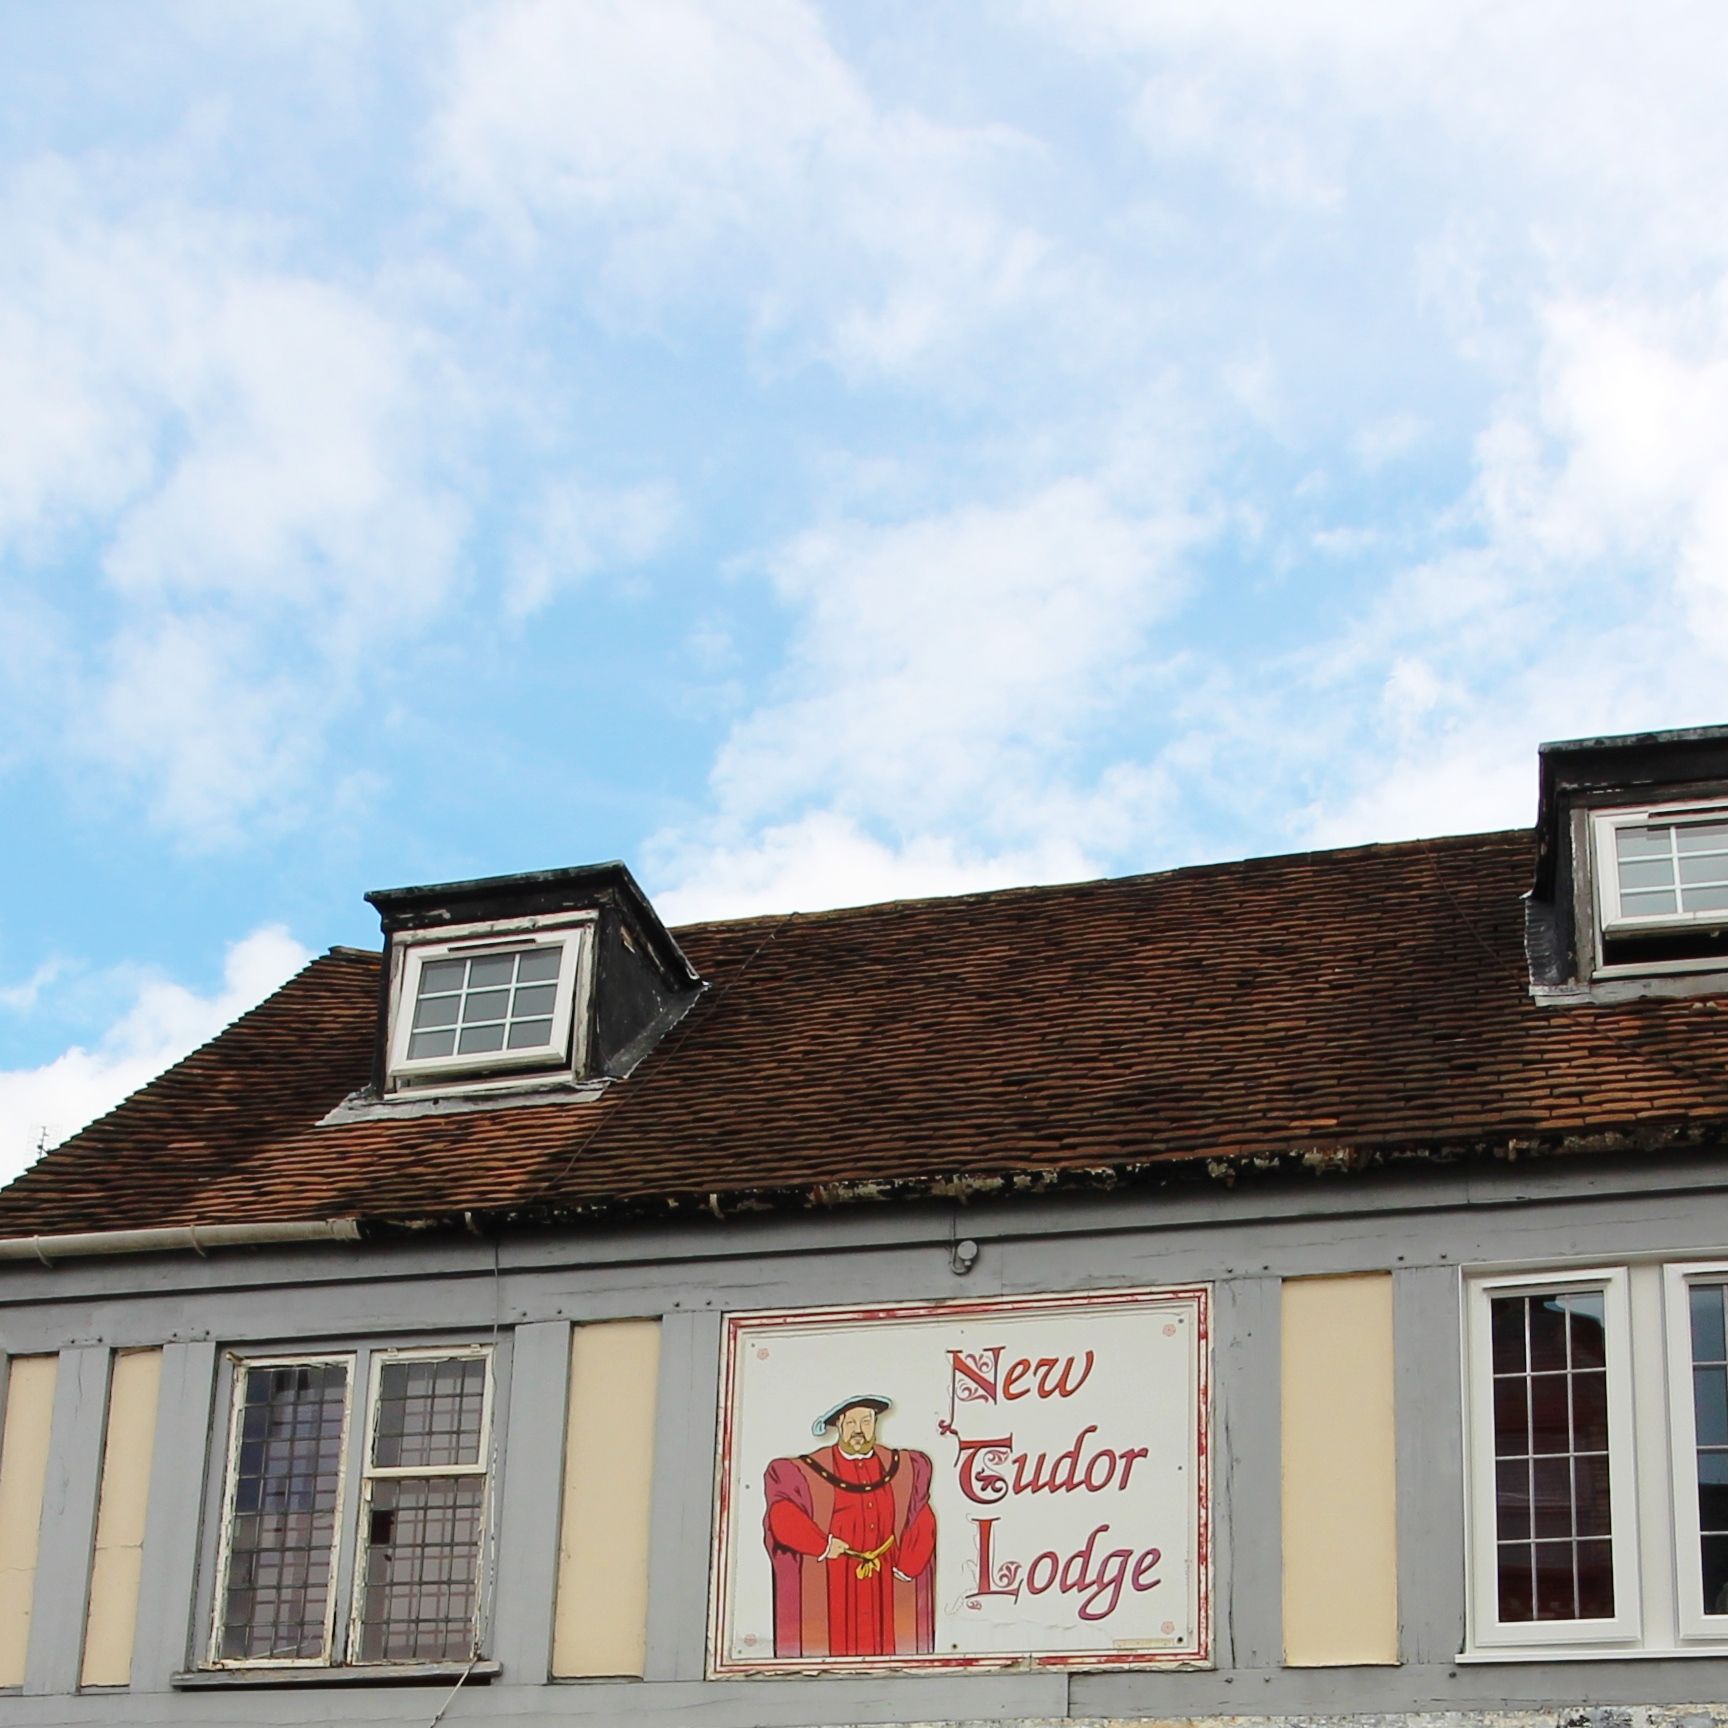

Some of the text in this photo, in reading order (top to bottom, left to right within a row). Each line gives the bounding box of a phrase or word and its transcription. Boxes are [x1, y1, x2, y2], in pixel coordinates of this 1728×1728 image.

[943, 1346, 1095, 1415] New
[954, 1425, 1150, 1505] Tudor
[963, 1517, 1163, 1621] Lodge
